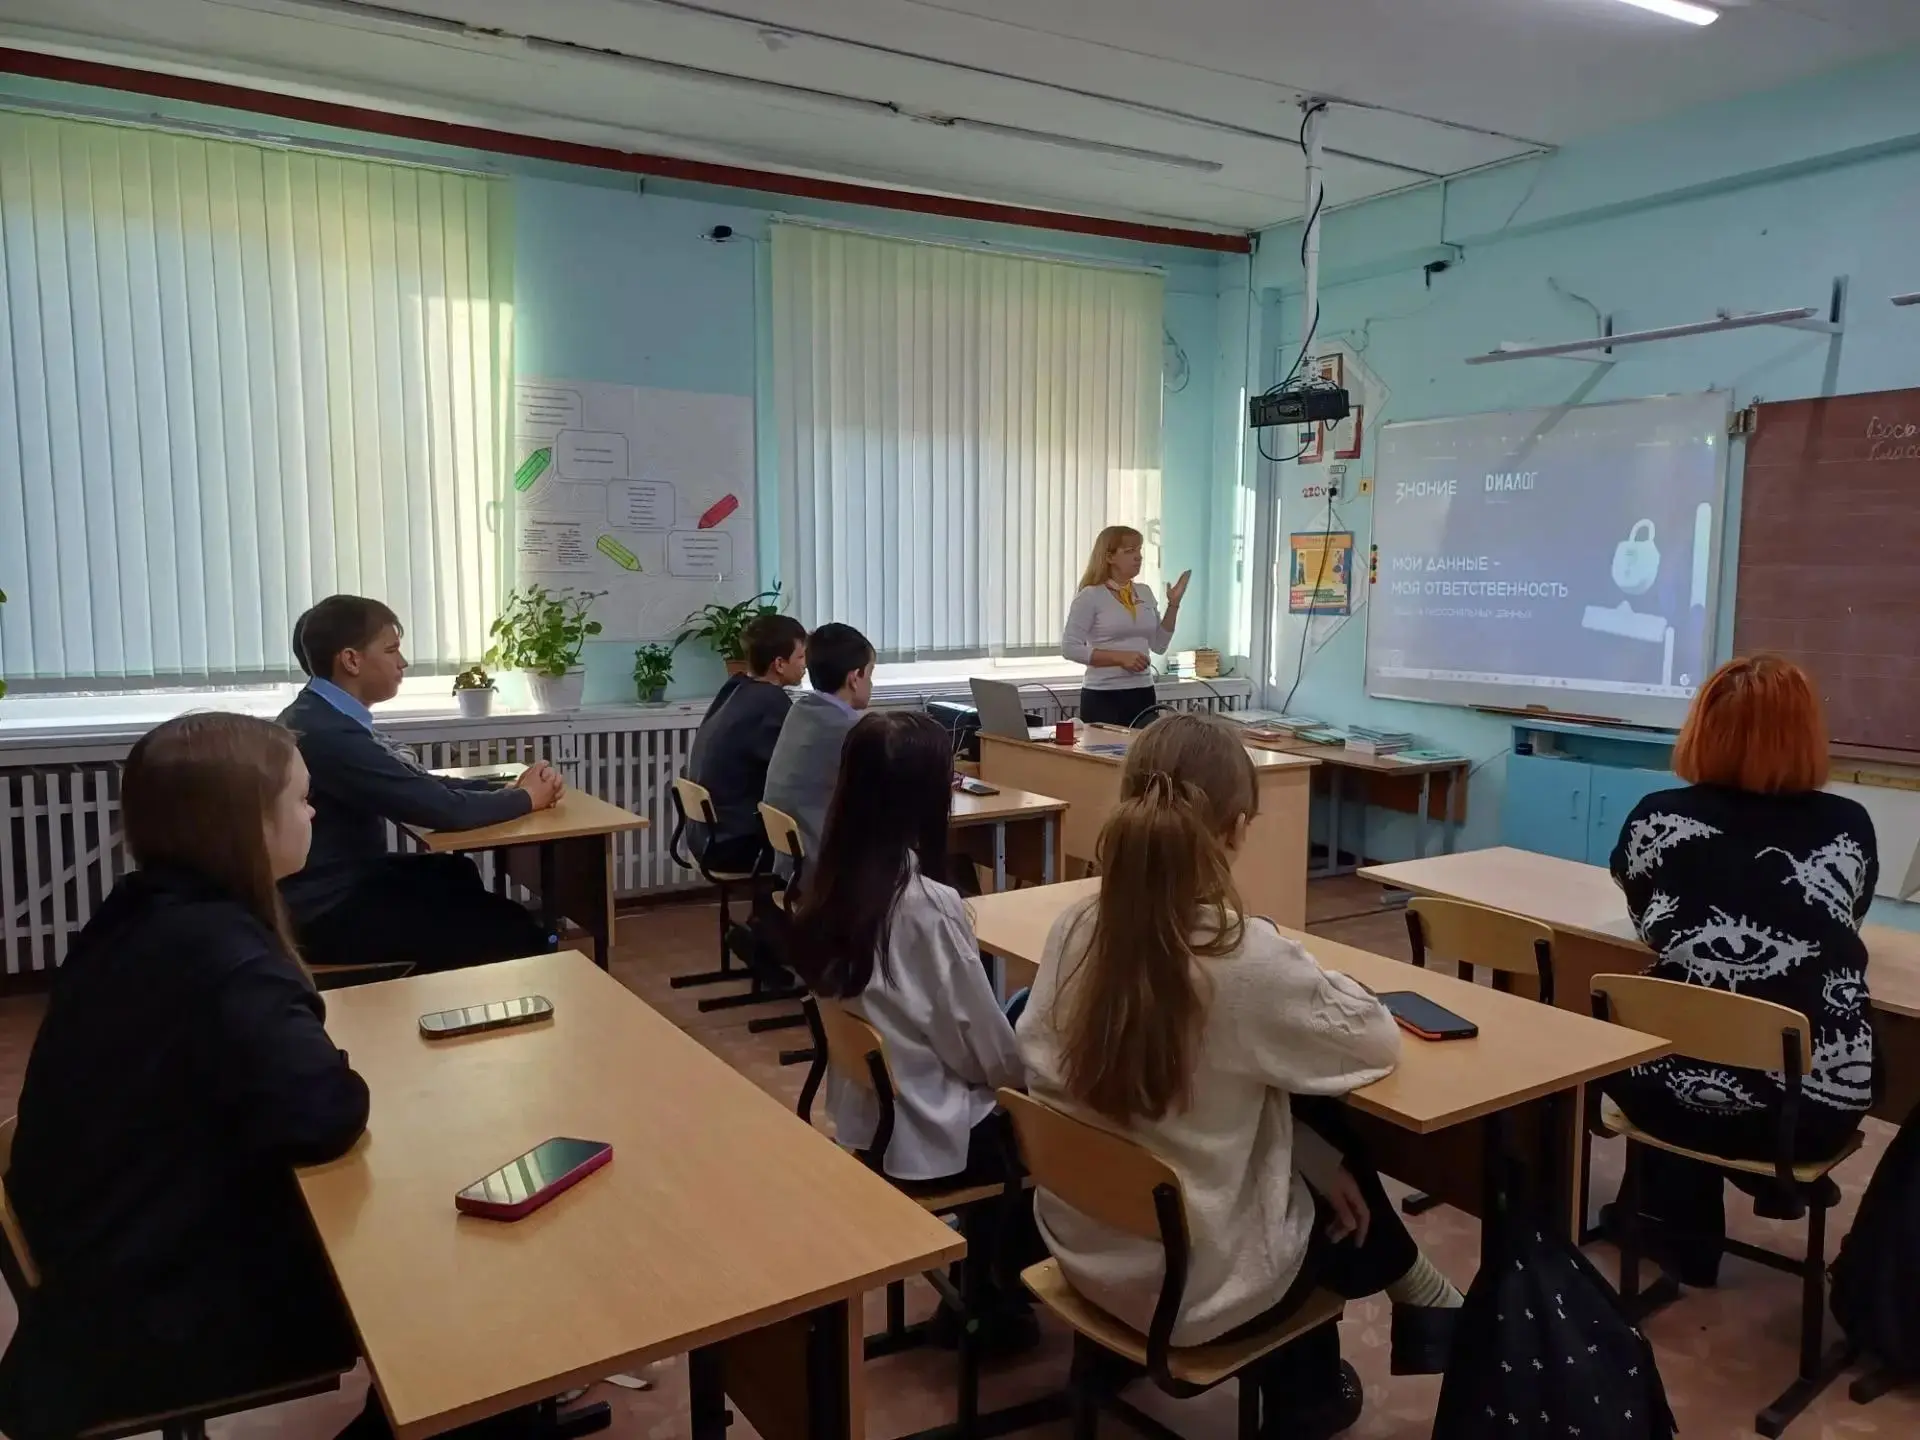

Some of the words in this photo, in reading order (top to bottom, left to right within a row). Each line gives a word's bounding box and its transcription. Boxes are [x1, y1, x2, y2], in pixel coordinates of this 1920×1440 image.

[1395, 479, 1458, 504] ЗНАНИЕ
[1426, 556, 1489, 572] ДАННЫЕ
[1391, 581, 1420, 596] МОЯ
[1424, 581, 1569, 598] ОТВЕТСТВЕННОСТЬ
